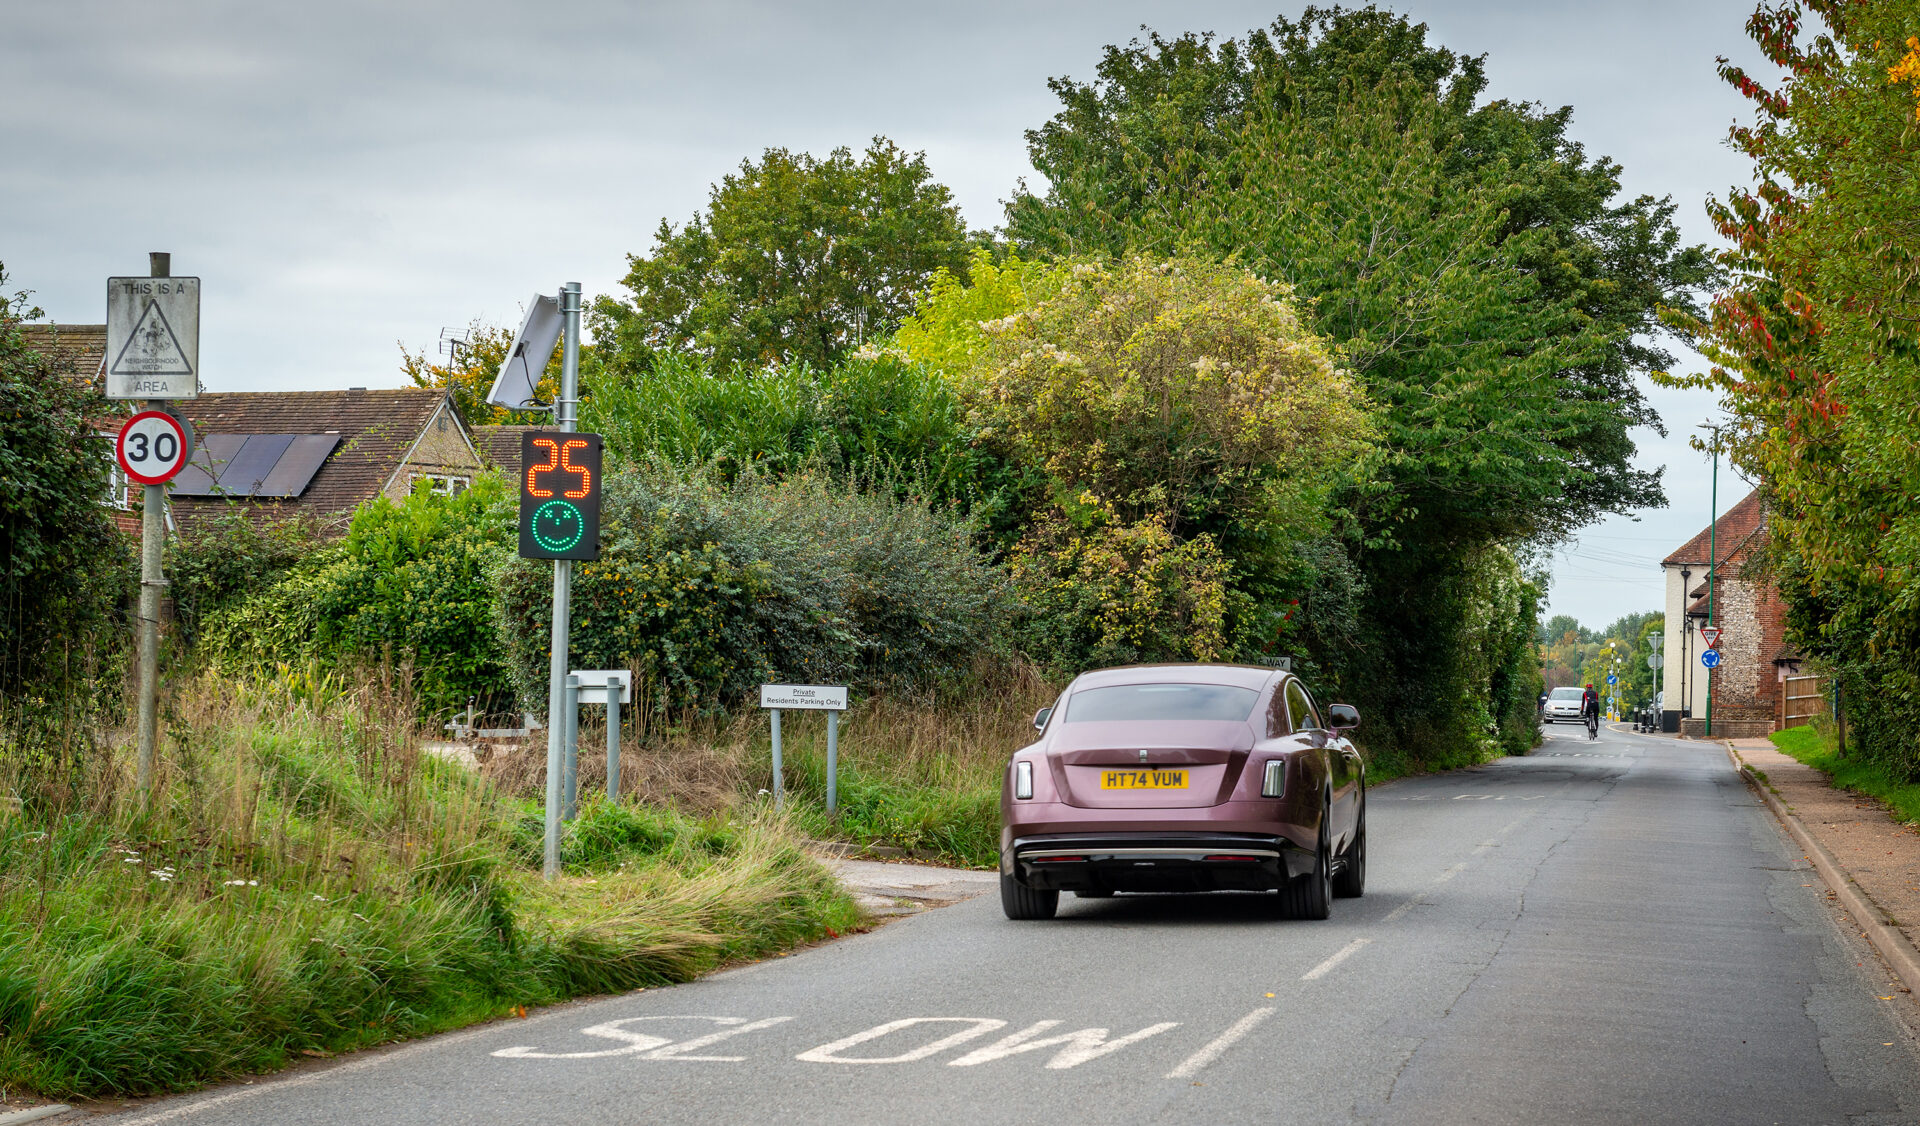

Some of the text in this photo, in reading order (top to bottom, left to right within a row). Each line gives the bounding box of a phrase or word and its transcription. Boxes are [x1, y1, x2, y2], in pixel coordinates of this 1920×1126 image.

[122, 283, 185, 295] THIS IS A
[125, 357, 180, 365] NEIGHBOURHOOD
[134, 381, 169, 392] AREA
[128, 432, 178, 462] 30
[527, 439, 591, 498] 25
[1266, 659, 1286, 668] WAY
[793, 688, 815, 696] Private
[1107, 772, 1183, 787] HT74 VUM
[489, 1015, 1184, 1069] SLOW
